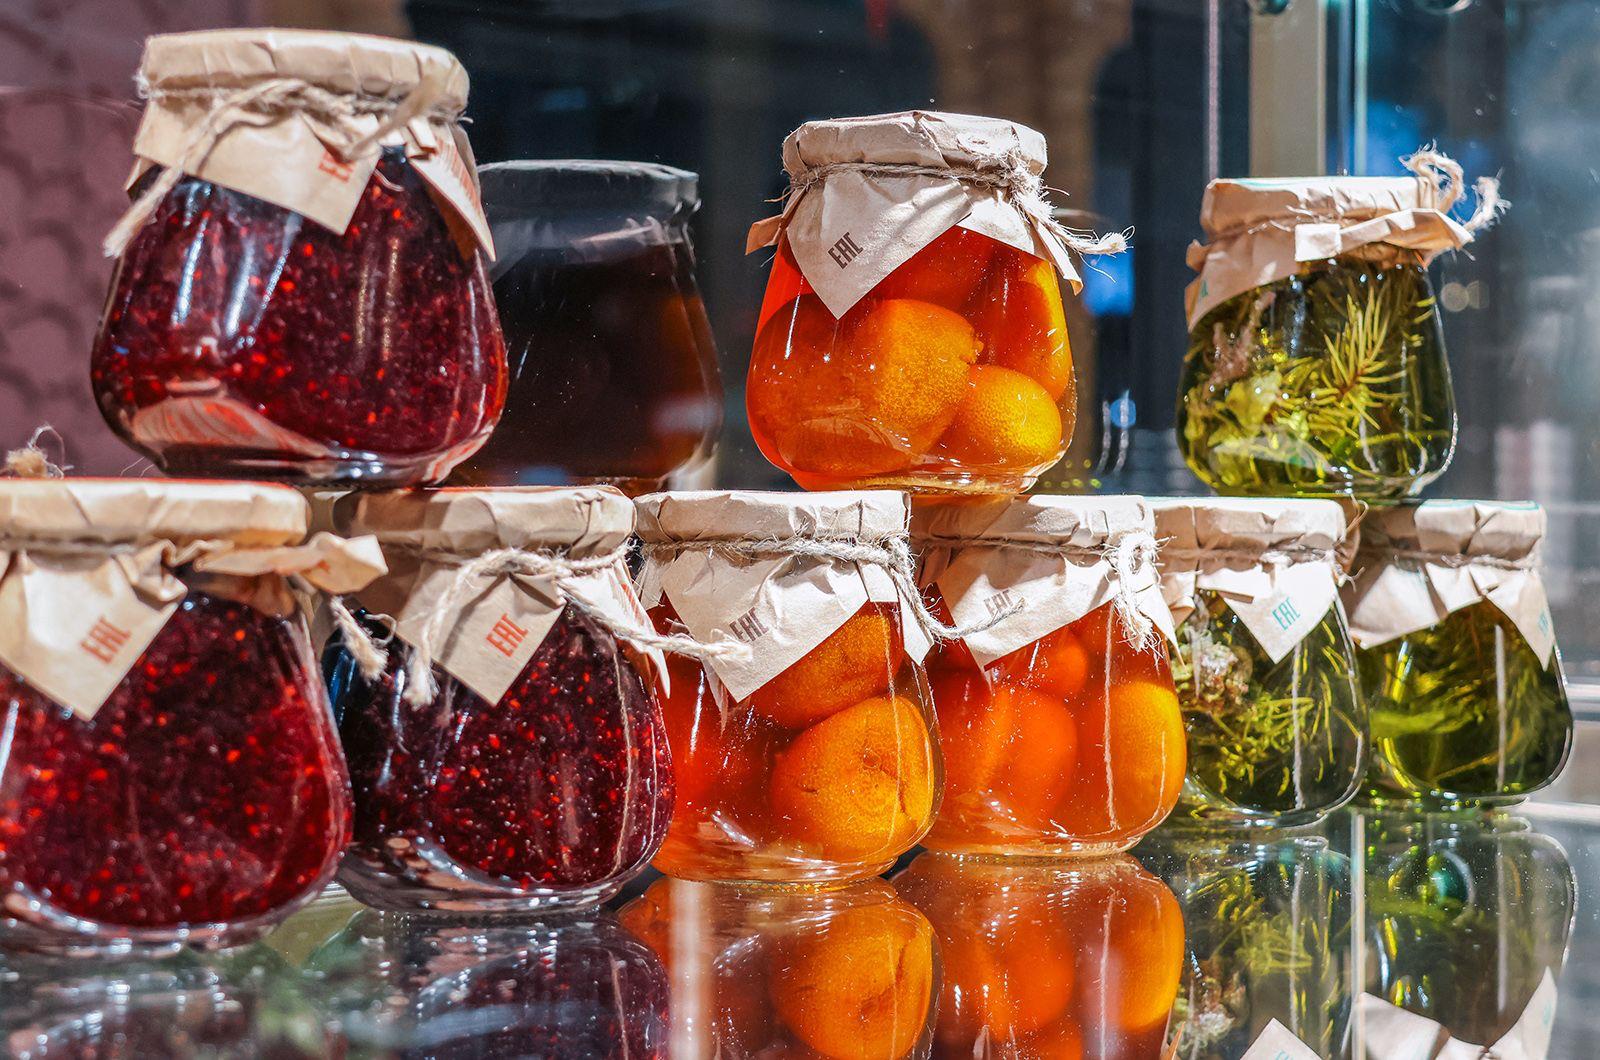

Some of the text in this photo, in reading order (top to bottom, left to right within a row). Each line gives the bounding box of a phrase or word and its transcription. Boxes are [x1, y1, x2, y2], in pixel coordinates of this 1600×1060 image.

[827, 231, 864, 270] EAC
[1272, 596, 1301, 630] EAC
[486, 613, 529, 657] EAC
